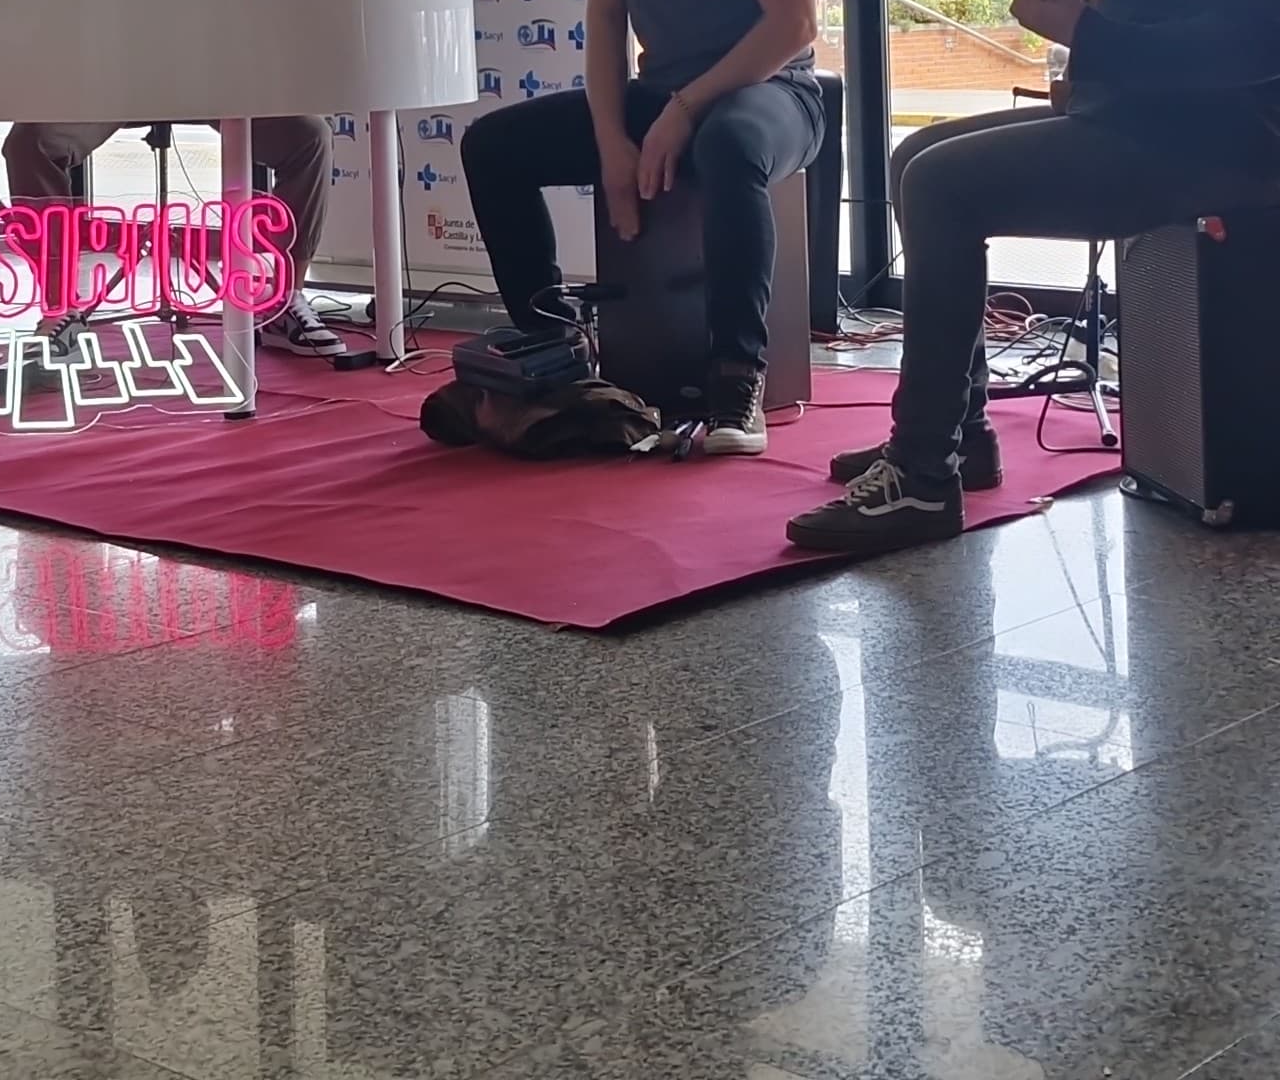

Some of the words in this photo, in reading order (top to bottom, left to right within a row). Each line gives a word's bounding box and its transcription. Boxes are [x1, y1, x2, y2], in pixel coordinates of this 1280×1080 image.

[484, 32, 503, 42] Sacyl
[542, 80, 561, 91] Sacyl
[341, 168, 359, 180] Sacyl
[438, 174, 457, 185] Sacyl
